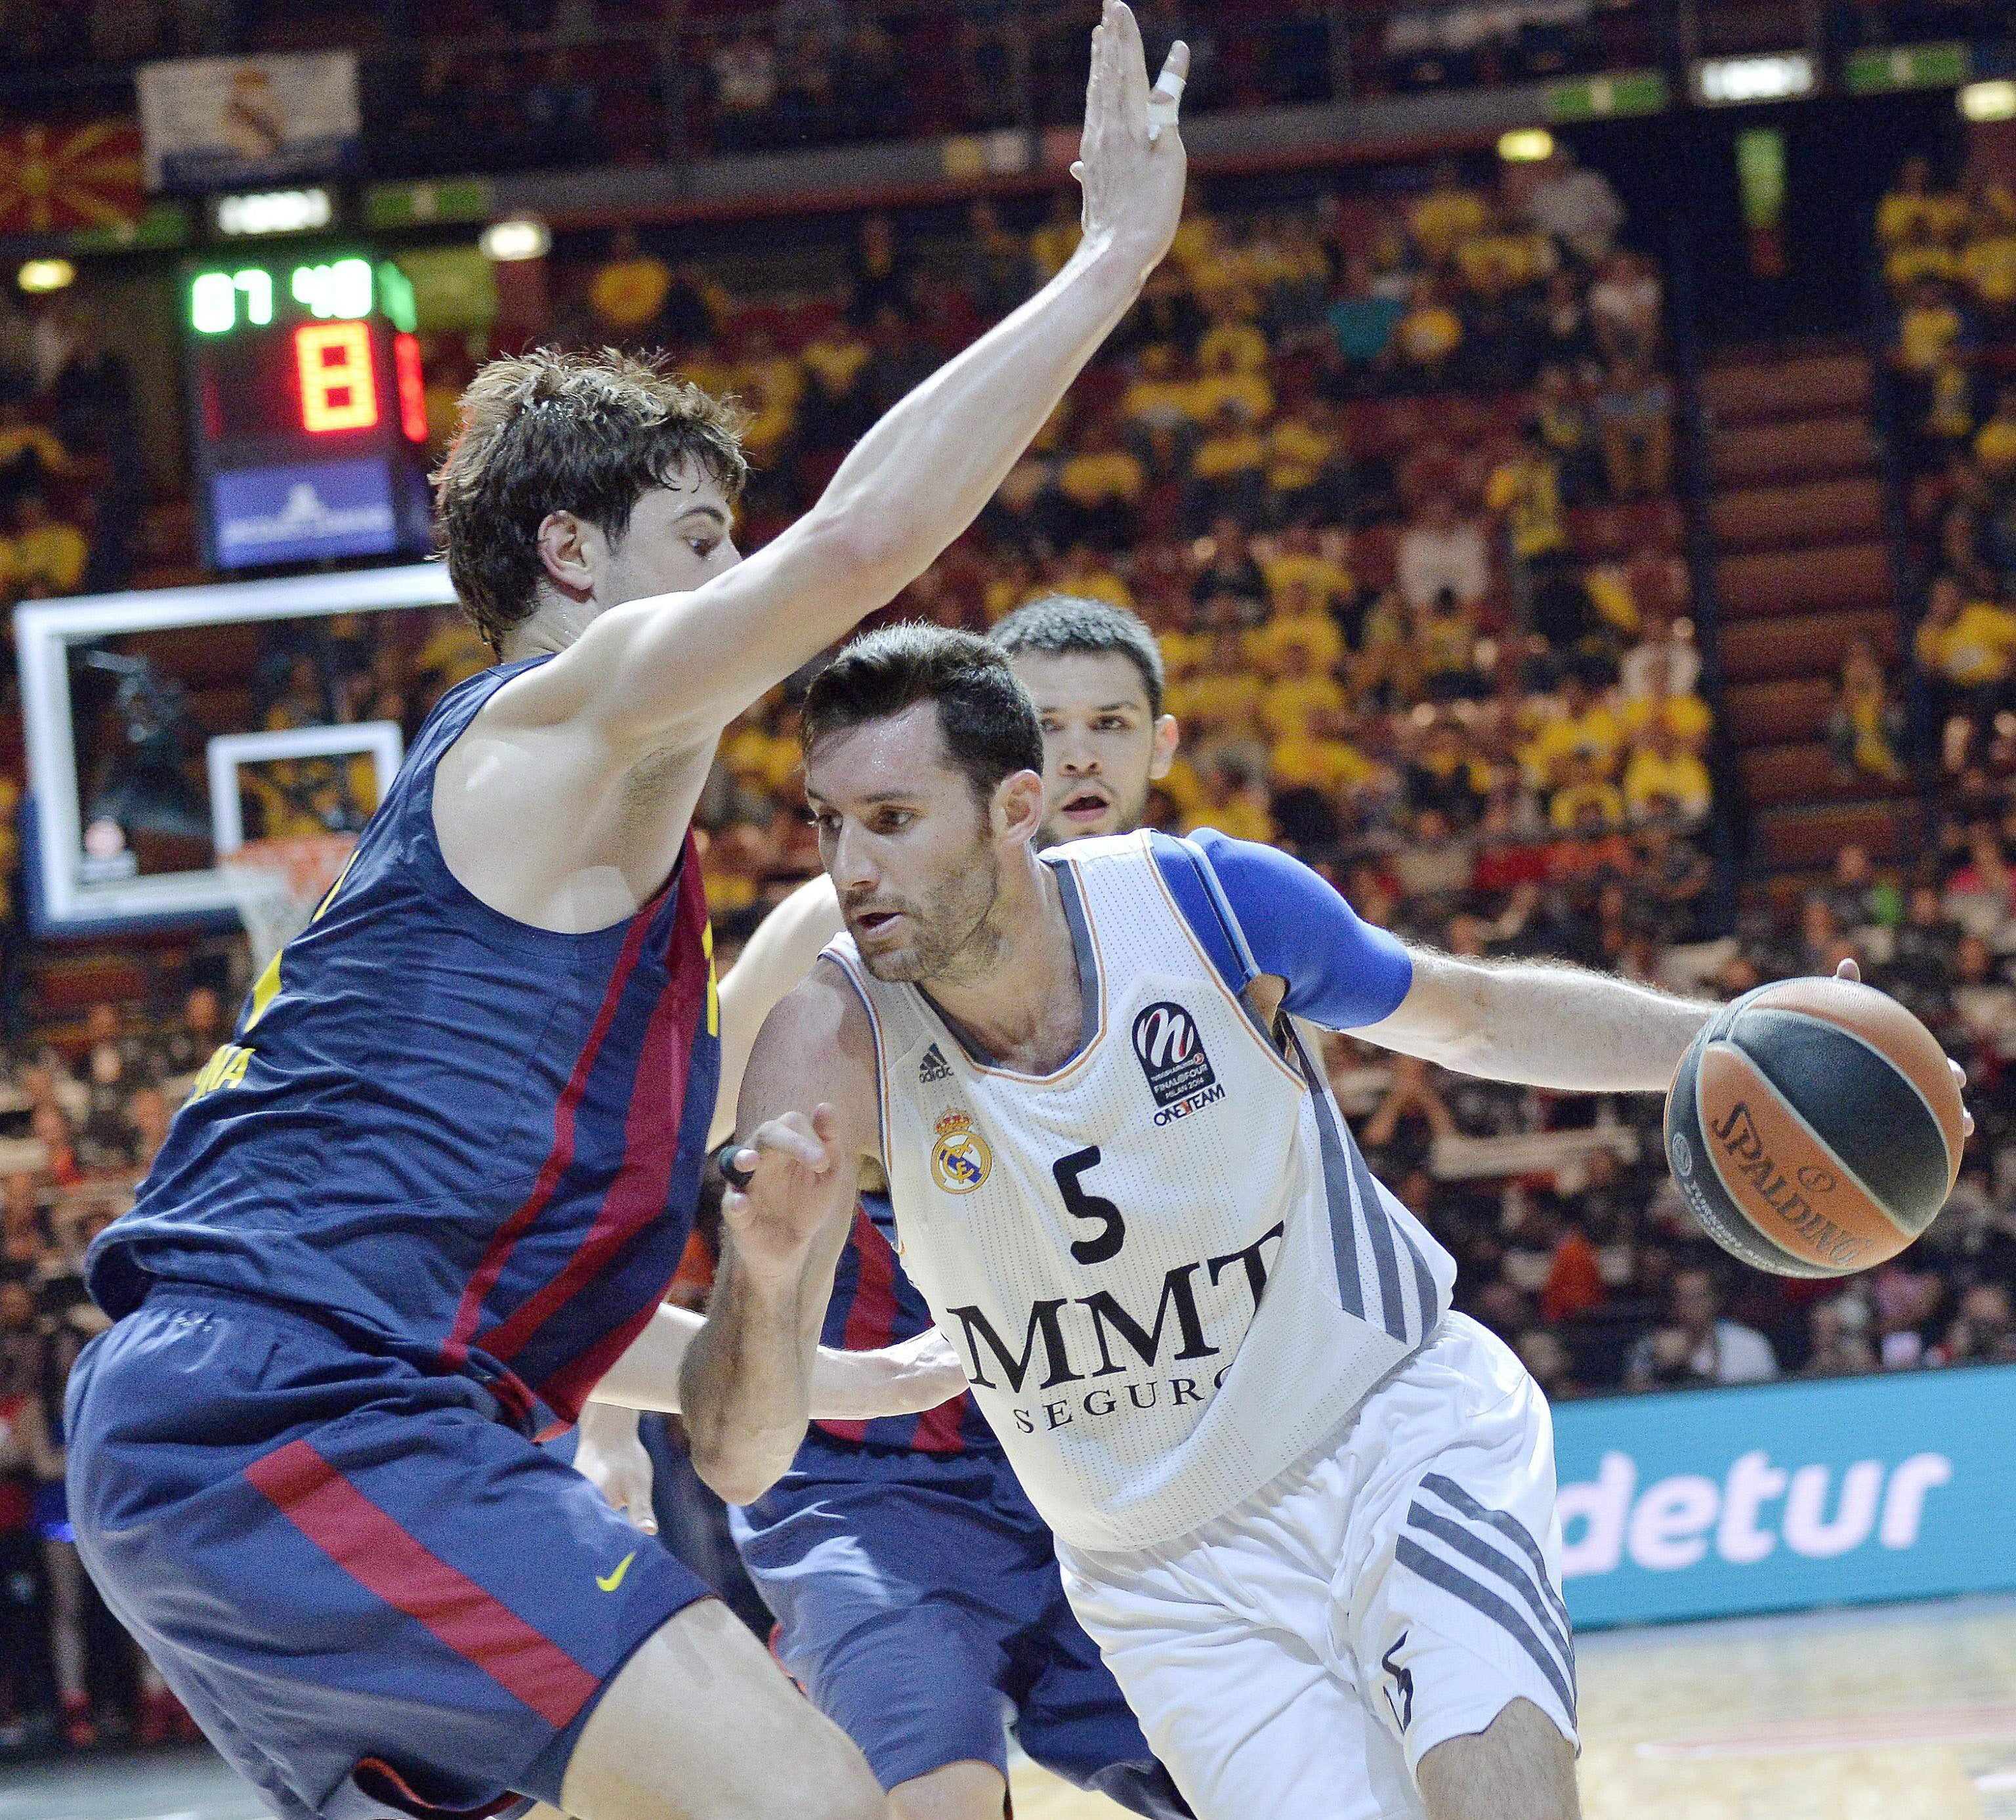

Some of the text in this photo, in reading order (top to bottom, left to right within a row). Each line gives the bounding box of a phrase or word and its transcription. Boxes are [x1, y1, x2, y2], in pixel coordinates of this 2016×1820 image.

[295, 320, 378, 433] 8
[1053, 1146, 1125, 1265] 5
[1710, 1099, 1861, 1265] SPALDING
[946, 1220, 1284, 1393] MMT
